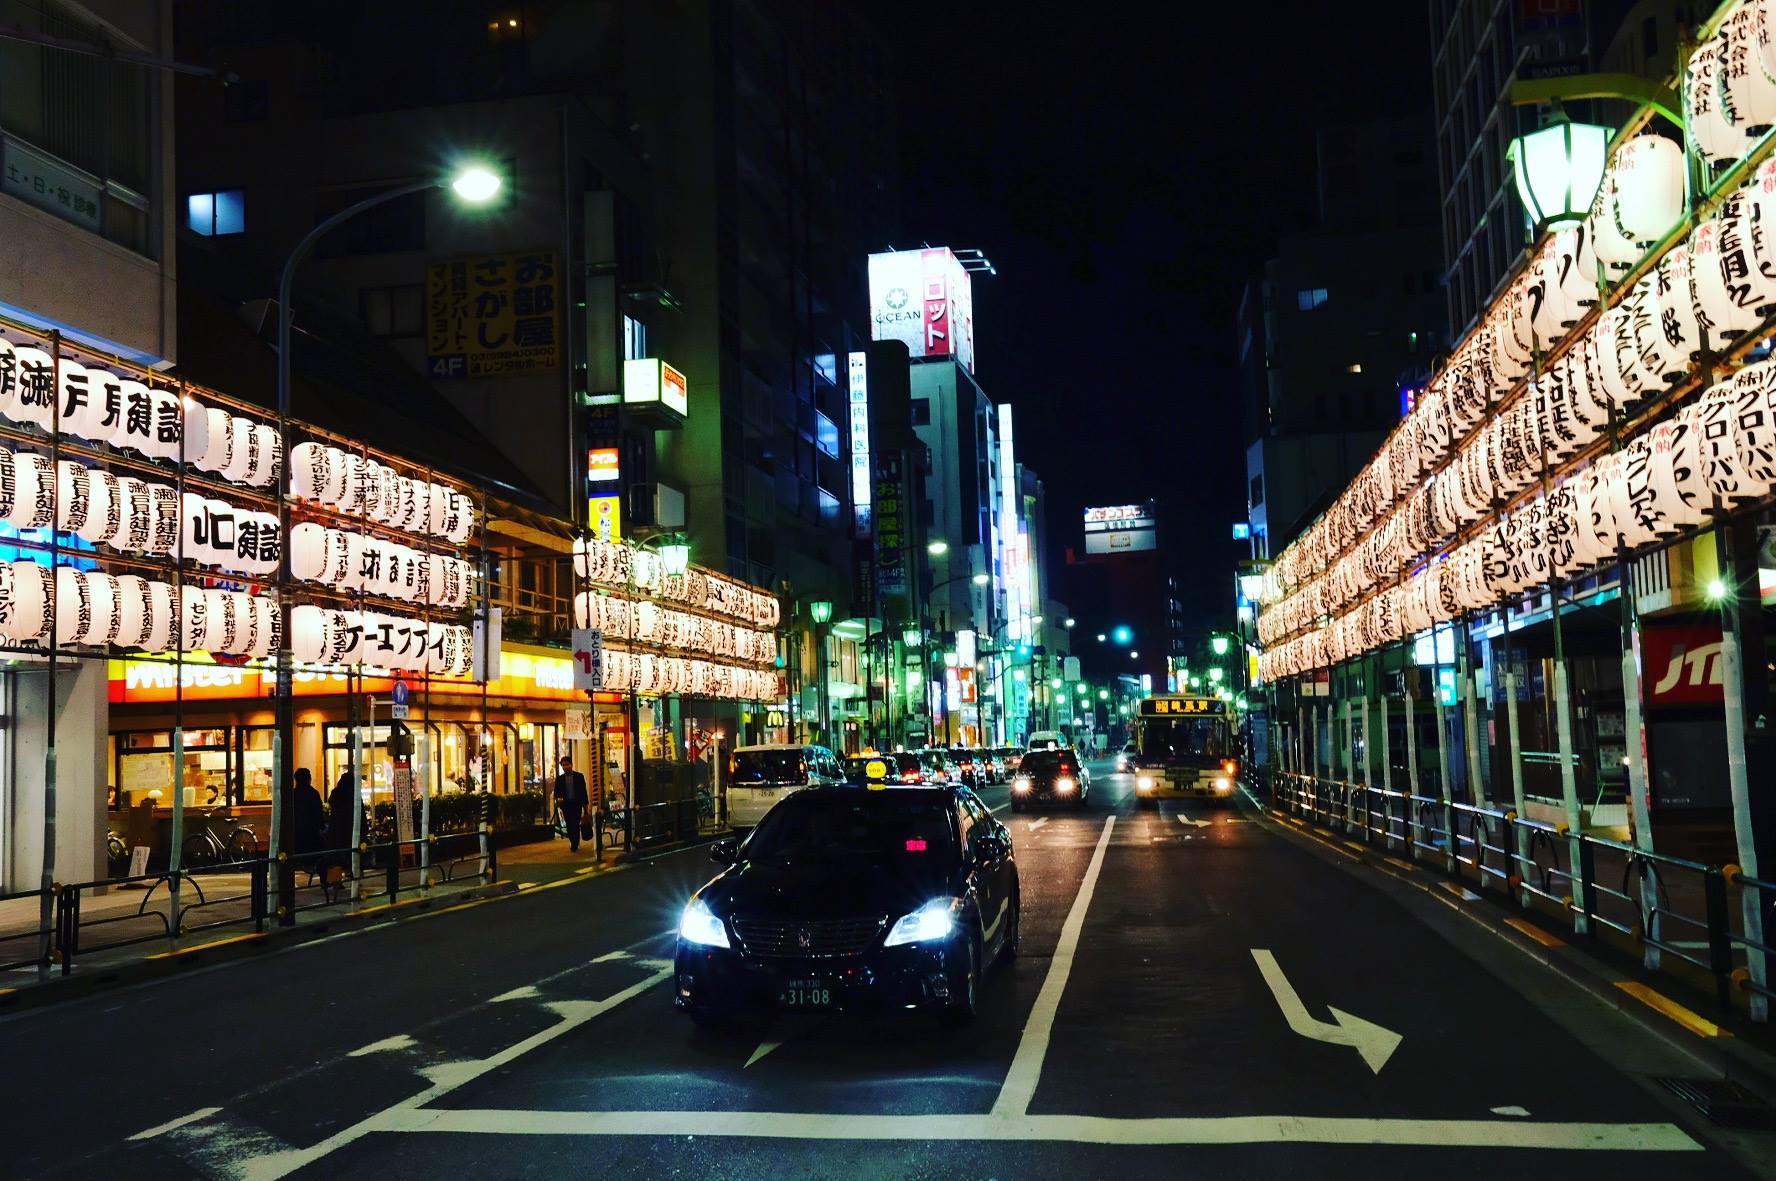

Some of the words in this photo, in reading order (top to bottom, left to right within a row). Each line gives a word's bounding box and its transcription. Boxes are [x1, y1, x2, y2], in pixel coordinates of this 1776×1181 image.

[475, 258, 509, 349] さがし
[513, 254, 555, 347] お部屋
[875, 310, 922, 325] OCEAN
[433, 357, 464, 377] 4F
[1703, 400, 1738, 494] グローバル
[193, 505, 283, 562] 山口建設
[788, 989, 830, 1005] 31-08
